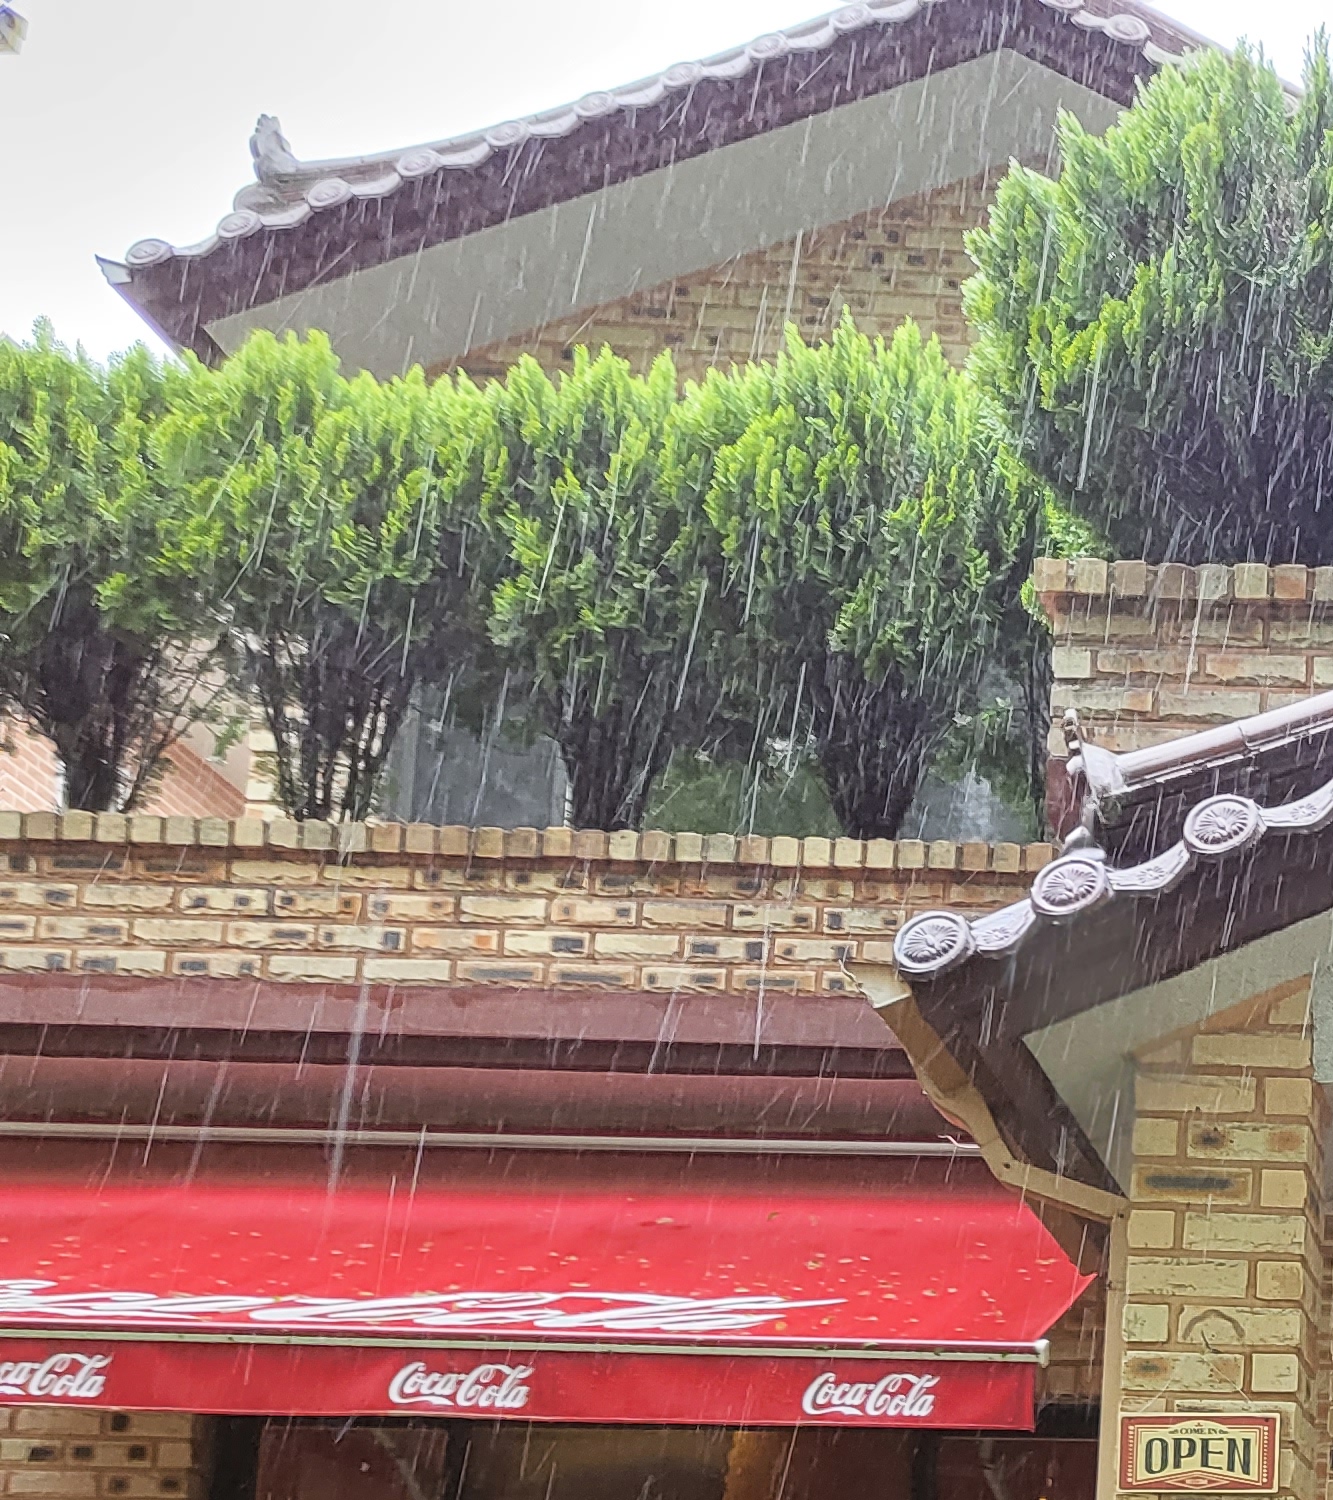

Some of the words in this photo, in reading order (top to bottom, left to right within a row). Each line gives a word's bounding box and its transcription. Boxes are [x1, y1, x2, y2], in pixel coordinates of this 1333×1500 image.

[388, 1361, 534, 1409] Coca-Cola
[803, 1372, 941, 1418] Coca-Cola
[1180, 1427, 1206, 1435] COME
[1144, 1436, 1253, 1476] OPEN
